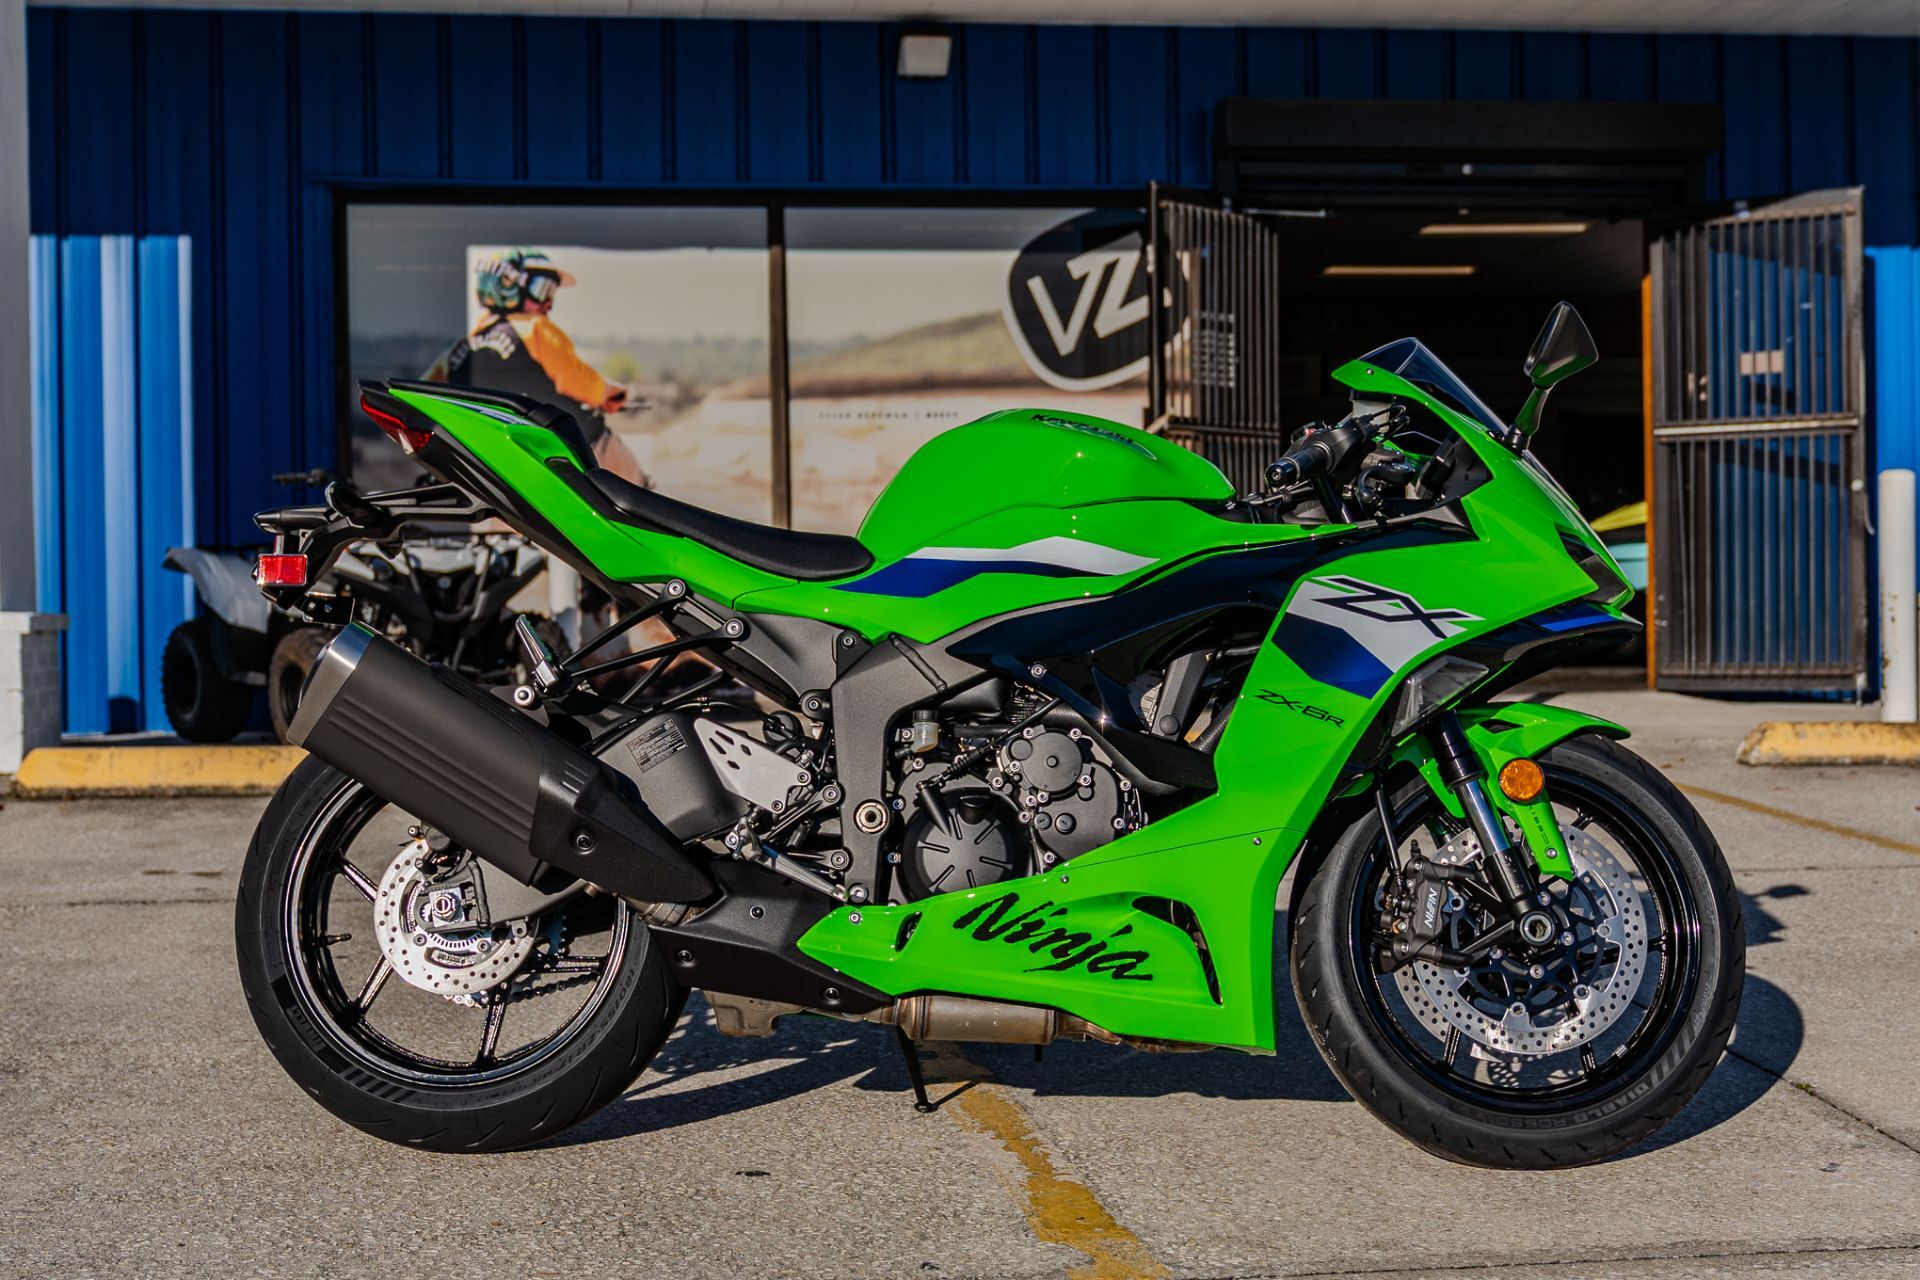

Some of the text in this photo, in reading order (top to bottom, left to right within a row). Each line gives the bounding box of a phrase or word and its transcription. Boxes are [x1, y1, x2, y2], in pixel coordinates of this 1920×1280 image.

[1310, 577, 1474, 640] ZX
[1253, 688, 1345, 728] ZX-6R
[953, 892, 1154, 981] Ninja
[1573, 1082, 1650, 1123] DIABLO
